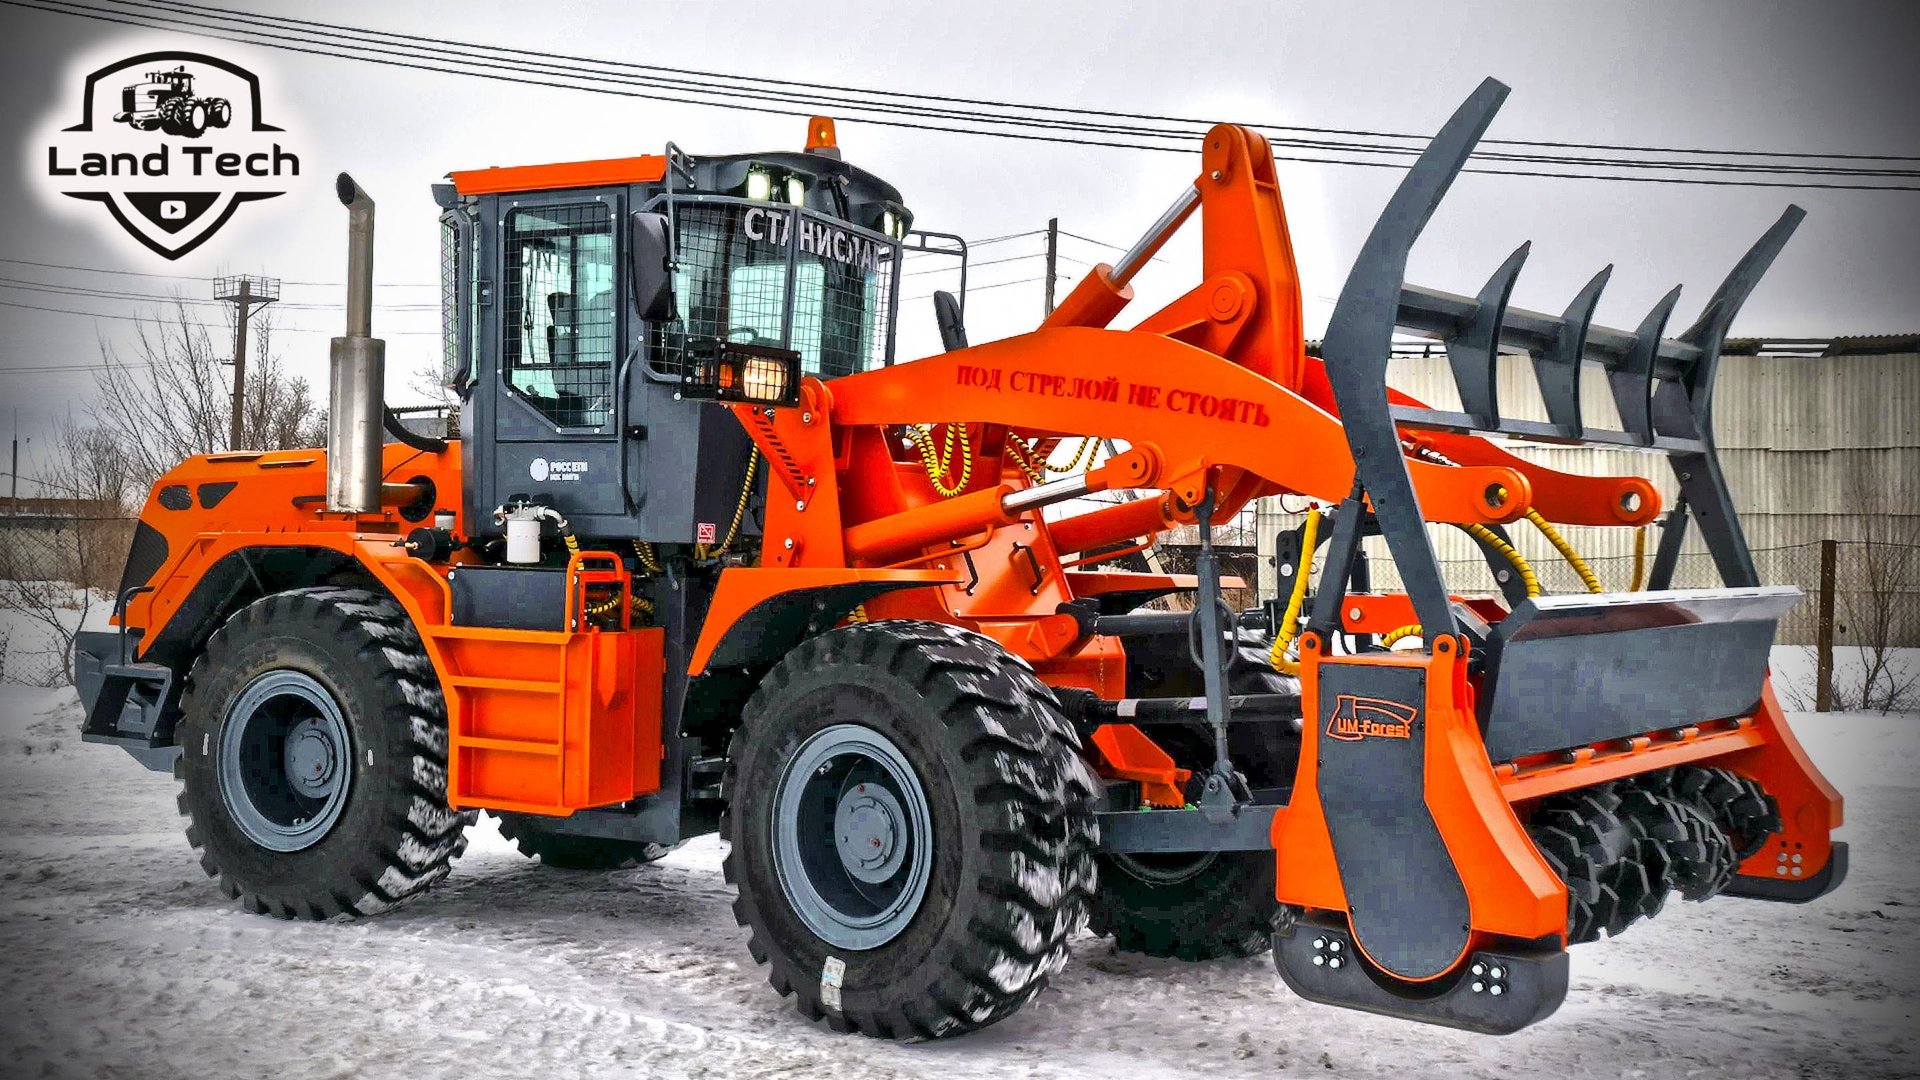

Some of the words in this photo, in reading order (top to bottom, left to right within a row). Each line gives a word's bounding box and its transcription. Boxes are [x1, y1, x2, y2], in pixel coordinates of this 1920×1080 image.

[956, 365, 1002, 393] ПОД
[1010, 370, 1120, 403] СТРЕЛОЙ
[1128, 384, 1161, 409] НЕ
[1166, 389, 1271, 428] СТОЯТЬ
